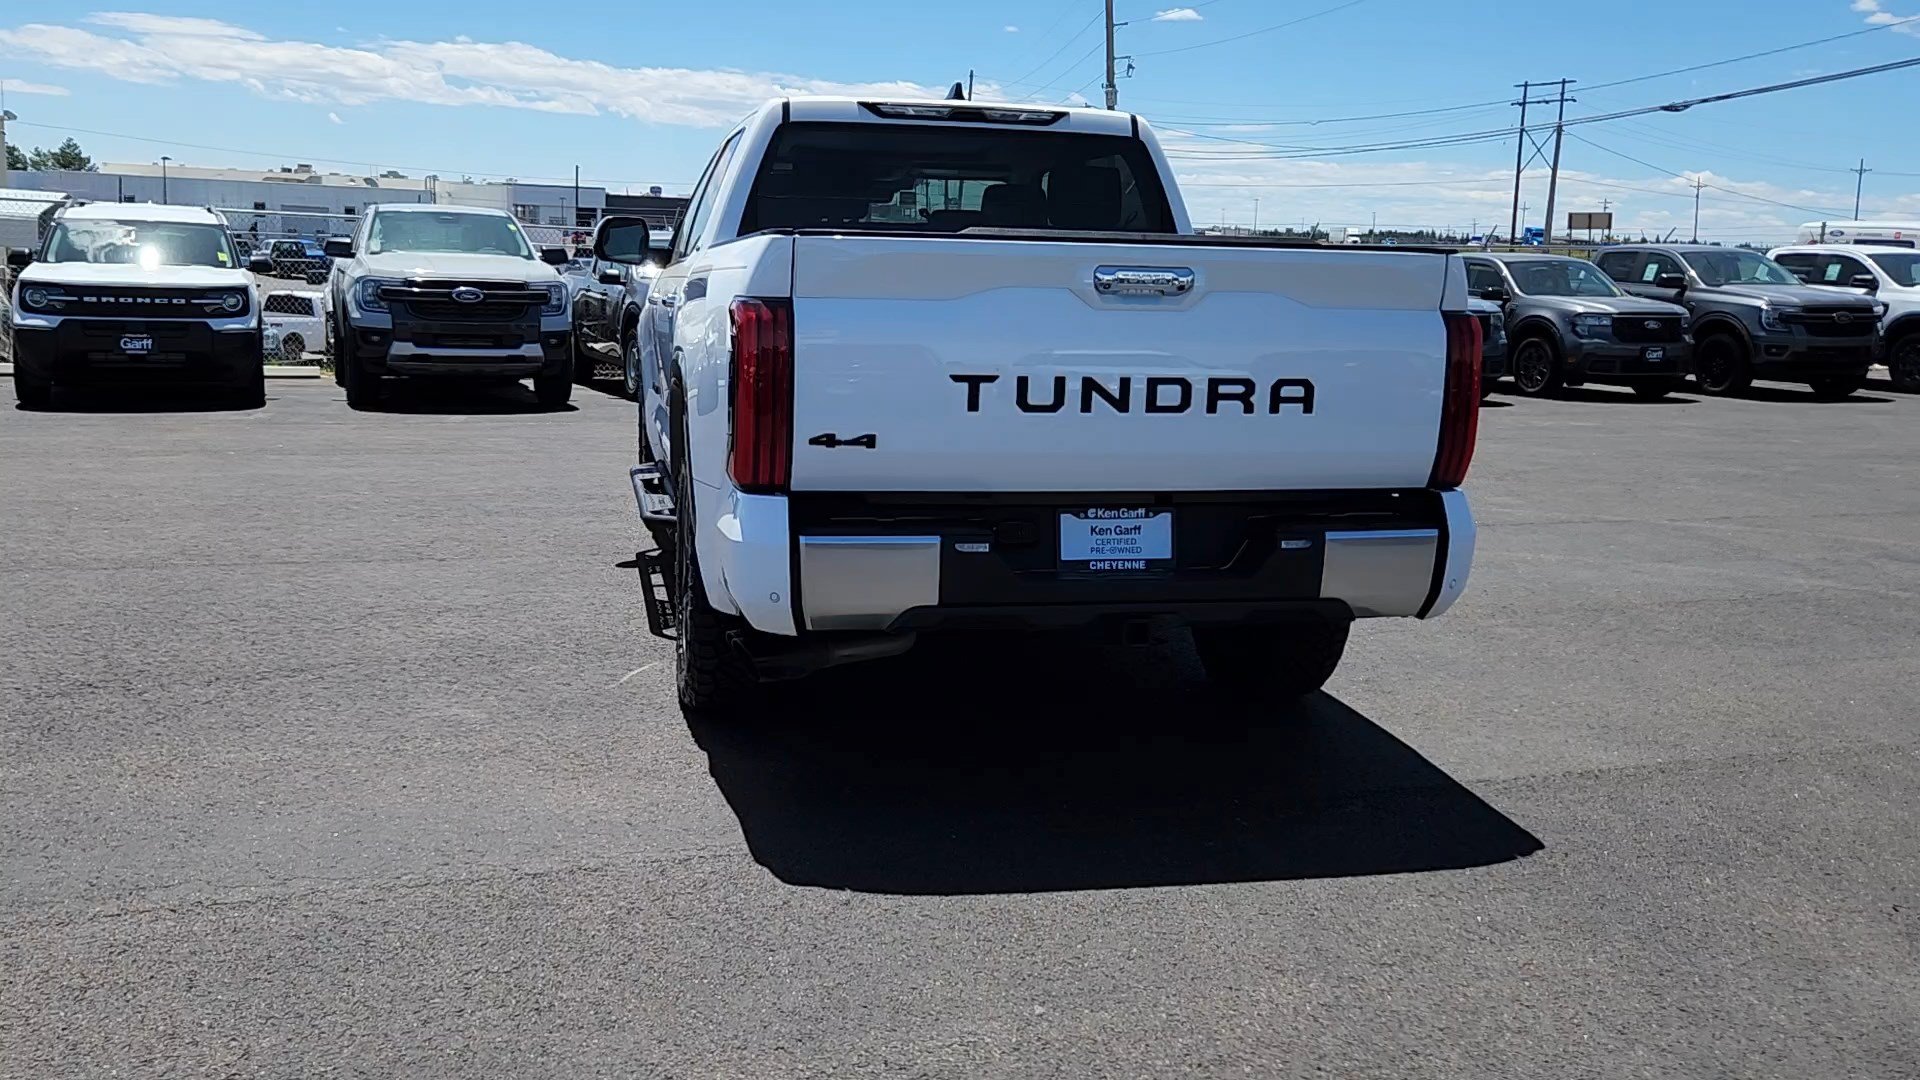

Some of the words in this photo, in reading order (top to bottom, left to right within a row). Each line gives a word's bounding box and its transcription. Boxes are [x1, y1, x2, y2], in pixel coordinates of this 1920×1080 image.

[83, 296, 186, 304] BRONCO
[120, 338, 153, 350] Garff
[949, 374, 1315, 415] TUNDRA
[1097, 508, 1118, 518] Ken
[1119, 507, 1146, 518] Garff
[1090, 525, 1113, 537] Ken
[1113, 524, 1143, 536] Garff
[1095, 537, 1137, 546] CERTIFIED
[1089, 560, 1147, 570] CHEYENNE
